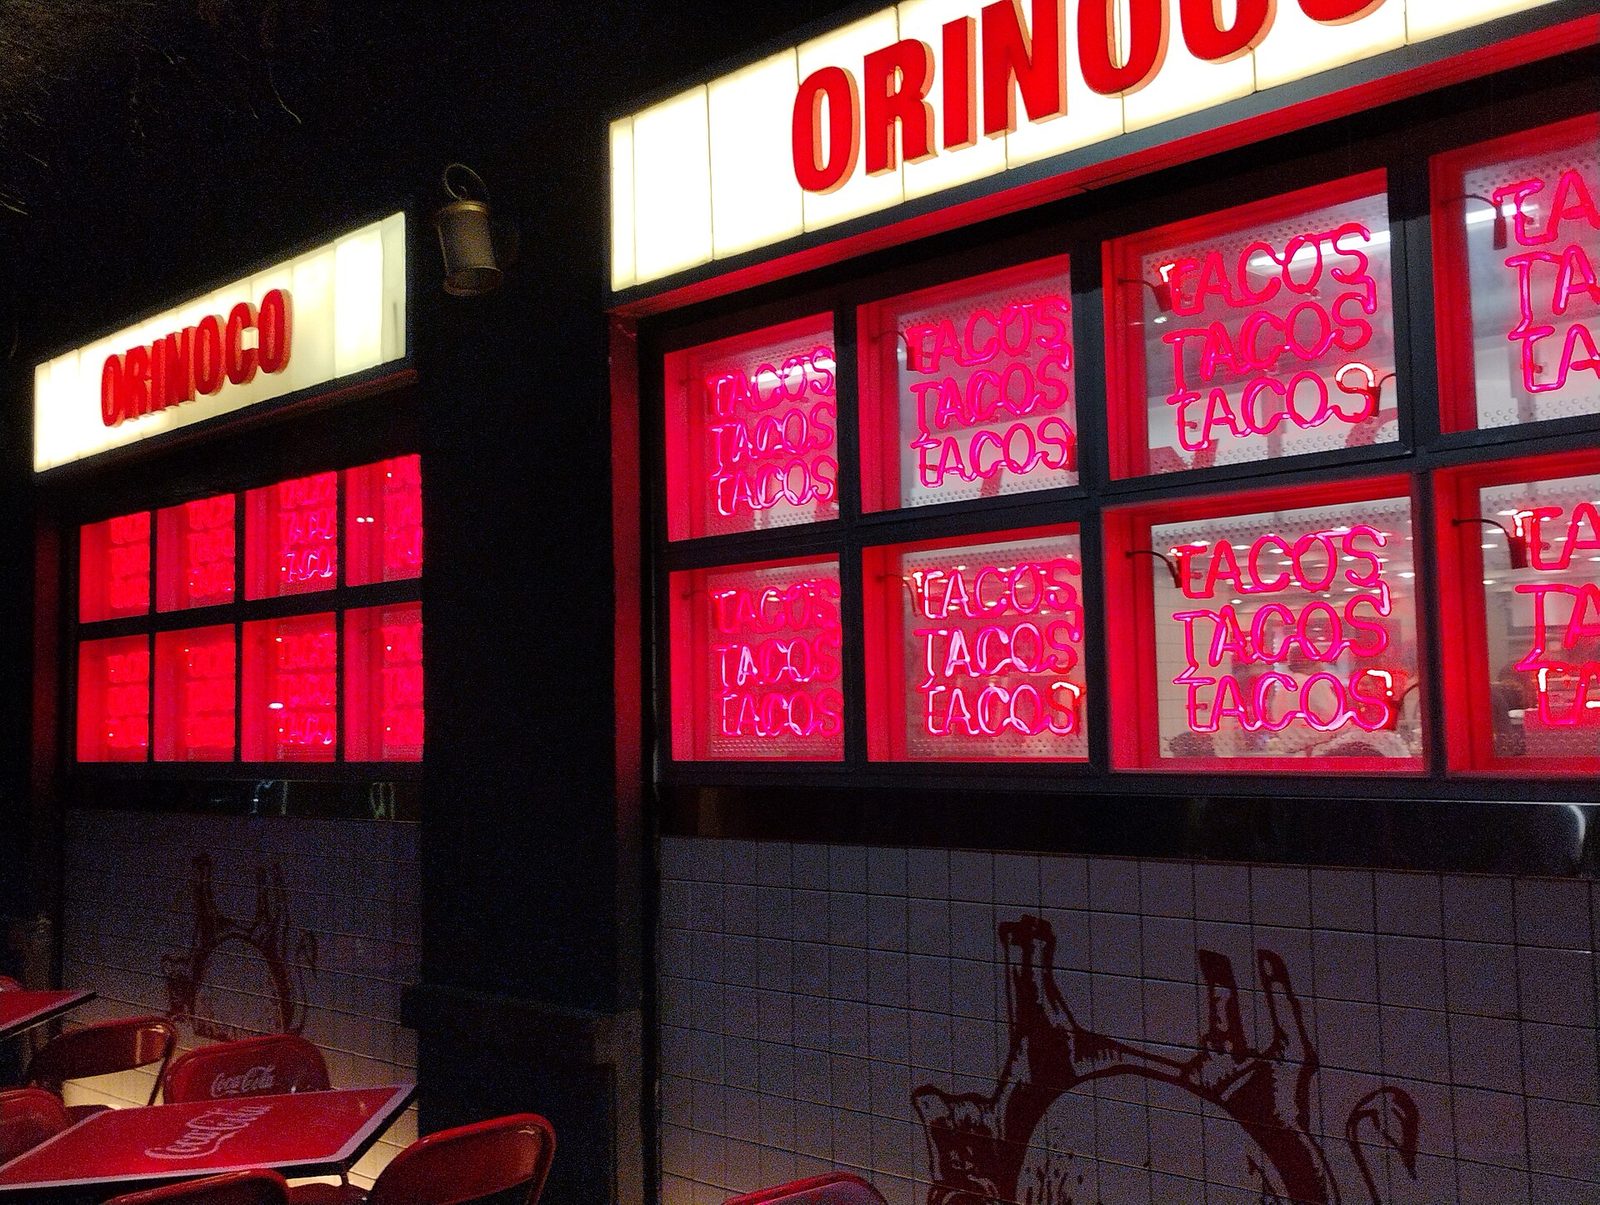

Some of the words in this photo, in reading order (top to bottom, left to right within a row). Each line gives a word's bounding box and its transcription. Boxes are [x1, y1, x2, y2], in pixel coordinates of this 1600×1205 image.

[793, 0, 1387, 194] ORINO
[1159, 222, 1376, 316] TACOS
[101, 288, 293, 427] ORINOCO
[905, 296, 1072, 375] TACOS
[1162, 291, 1373, 397] TACOS
[707, 346, 837, 418] TACOS
[911, 355, 1072, 437] TACOS
[1166, 362, 1378, 452] TACOS
[711, 400, 838, 475] TACOS
[911, 416, 1077, 488] TACOS
[711, 456, 840, 517] TACOS
[911, 559, 1082, 620] TACOS
[1168, 524, 1388, 600] TACOS
[710, 578, 843, 634] TACOS
[1172, 593, 1391, 668] TACOS
[713, 629, 843, 690] TACOS
[913, 620, 1082, 683] TACOS
[717, 687, 844, 738] TACOS
[919, 681, 1082, 736] TACOS
[1174, 667, 1393, 733] TACOS
